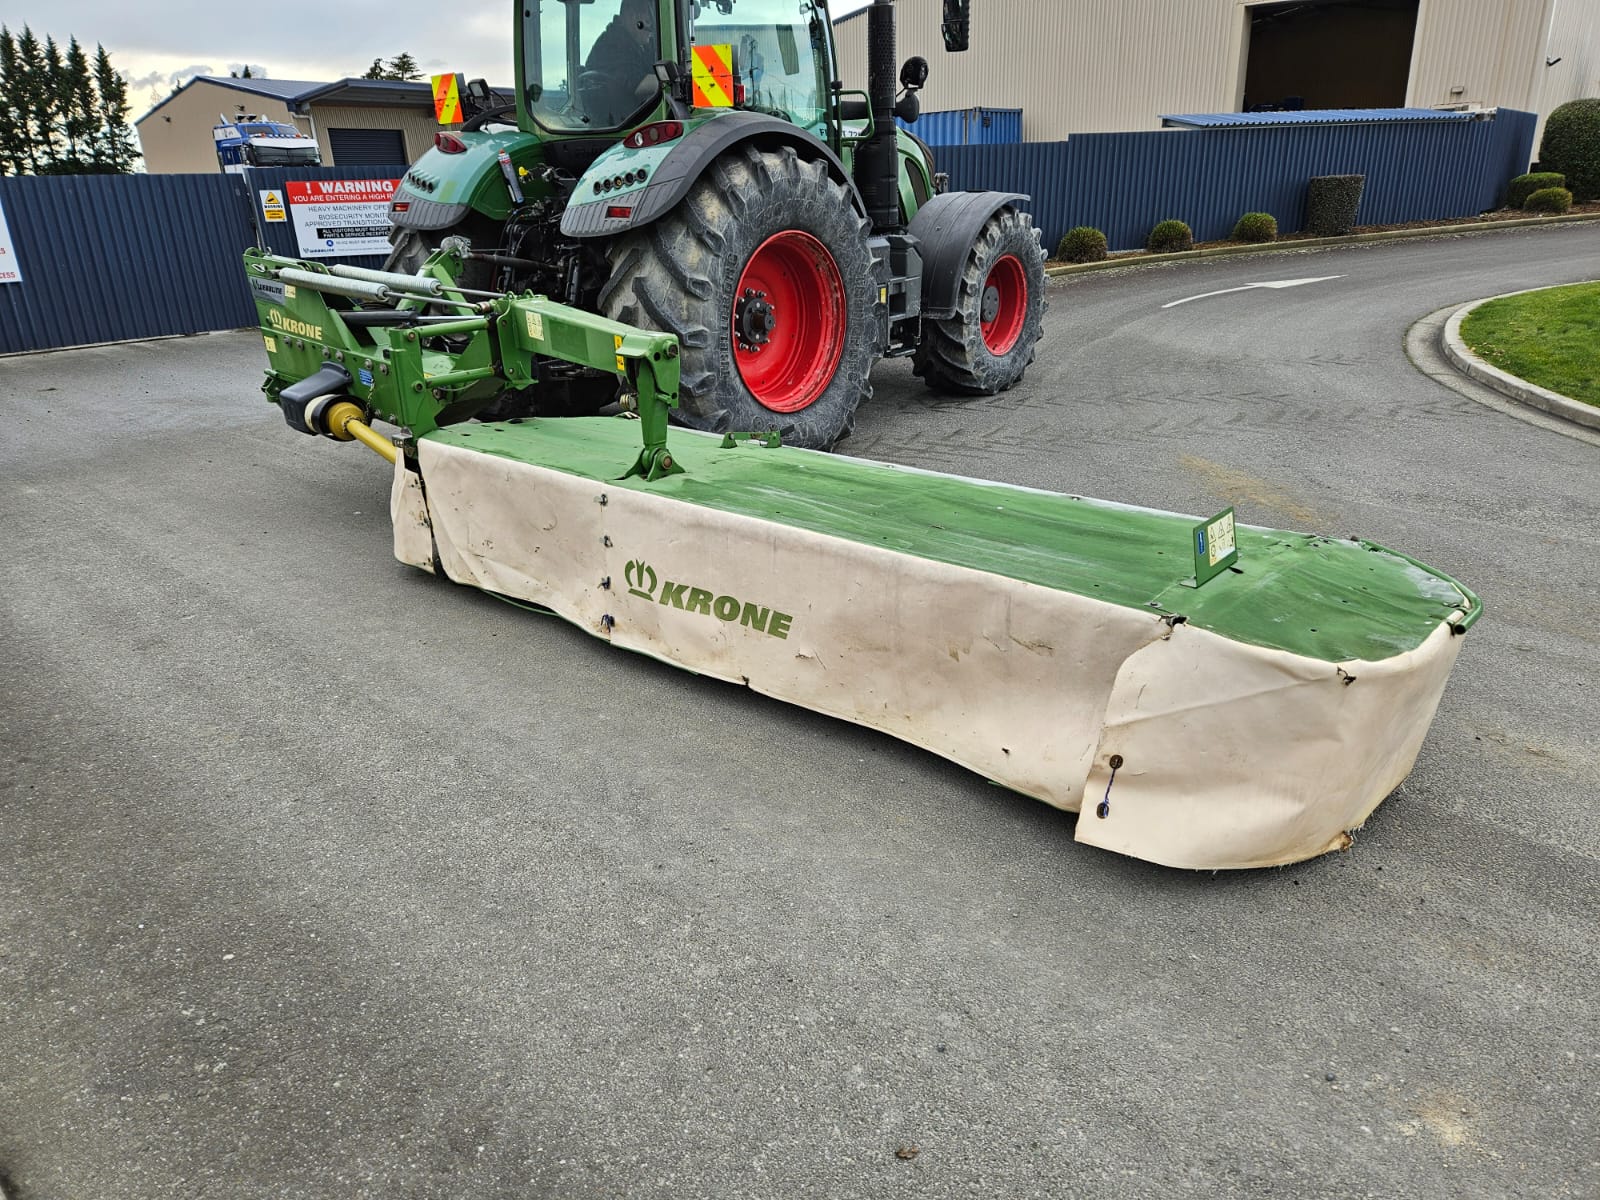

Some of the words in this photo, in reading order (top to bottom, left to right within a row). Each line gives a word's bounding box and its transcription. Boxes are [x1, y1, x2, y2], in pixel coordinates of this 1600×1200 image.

[319, 181, 394, 194] WARNING
[292, 195, 309, 203] YOU
[325, 194, 361, 202] ENTERING
[308, 205, 332, 213] HEAVY
[333, 204, 372, 212] MACHINERY
[318, 213, 363, 221] BIOSECURITY
[365, 212, 389, 220] MONIT
[304, 220, 342, 228] APPROVED
[343, 218, 391, 226] TRANSITIONAL
[282, 317, 323, 341] KRONE
[658, 581, 794, 640] KRONE
